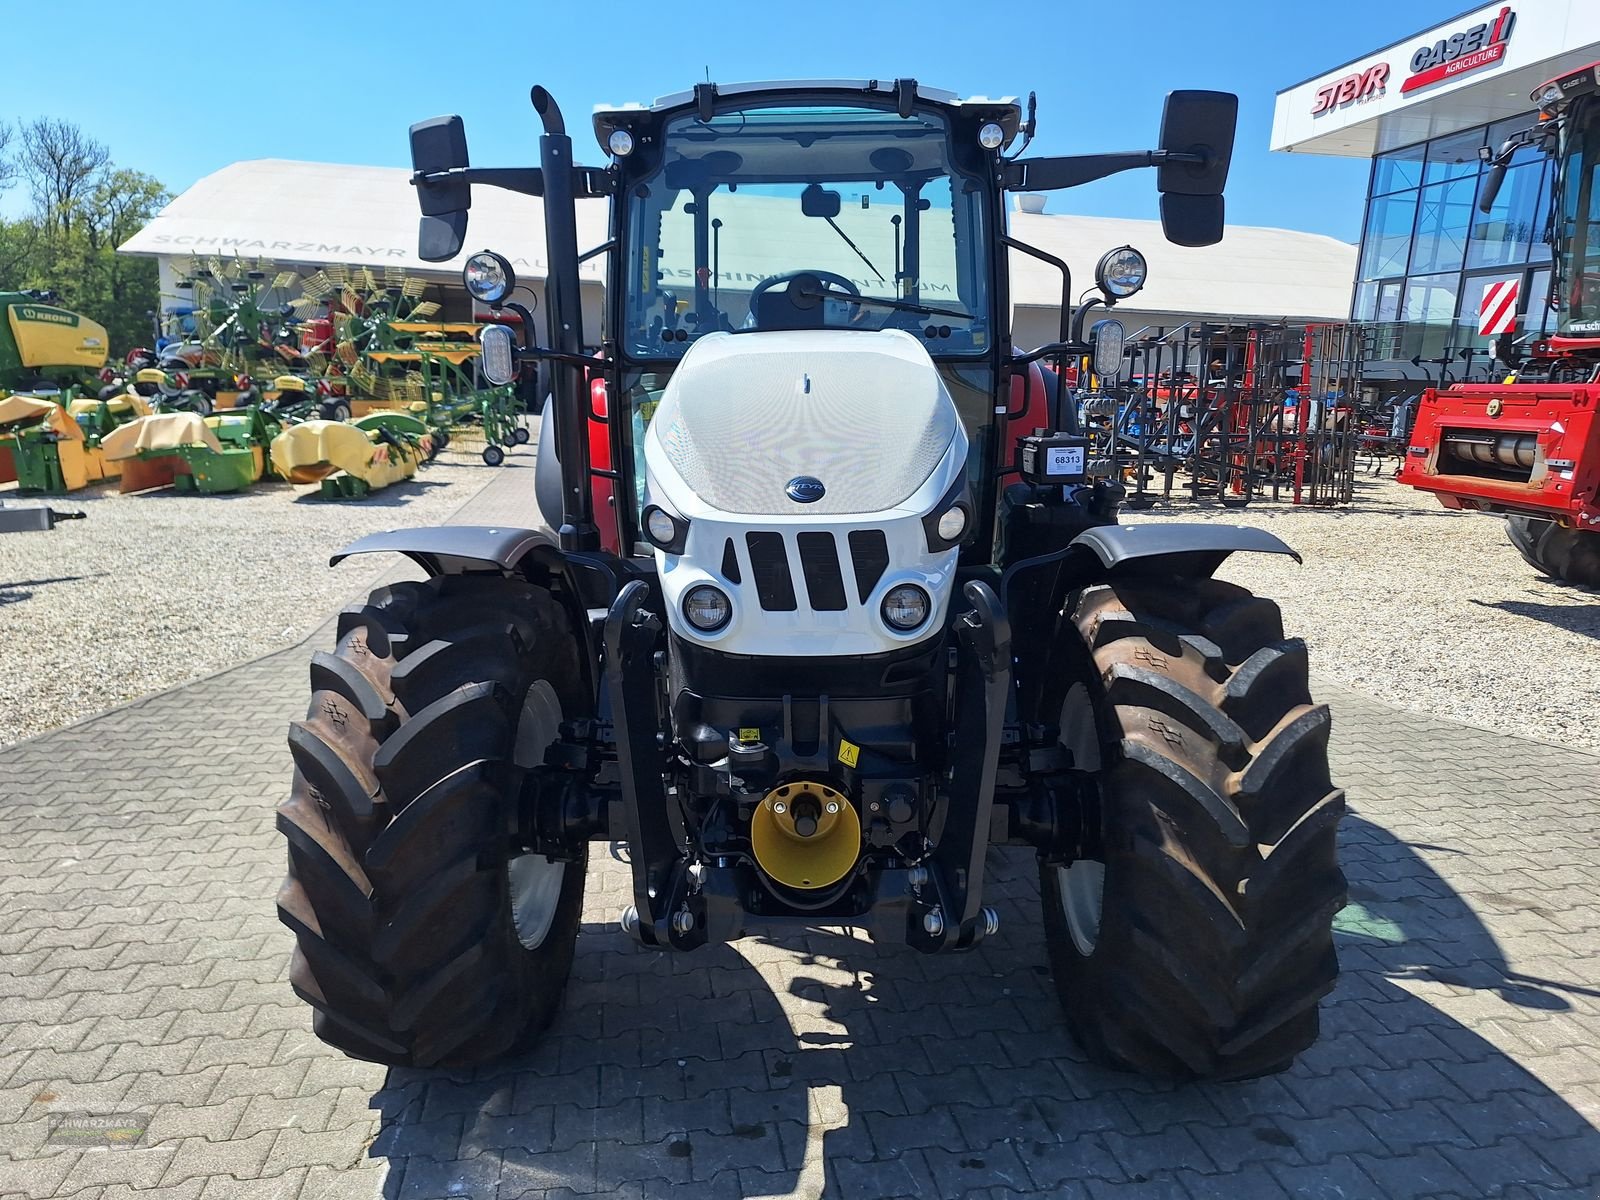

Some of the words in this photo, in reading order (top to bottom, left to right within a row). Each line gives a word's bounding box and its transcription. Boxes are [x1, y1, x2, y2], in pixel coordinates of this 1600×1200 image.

[1445, 47, 1499, 75] AGRICULTURE
[1311, 62, 1390, 114] STEYR
[152, 234, 406, 257] SCHWARZMAYR
[1055, 456, 1080, 464] 68313
